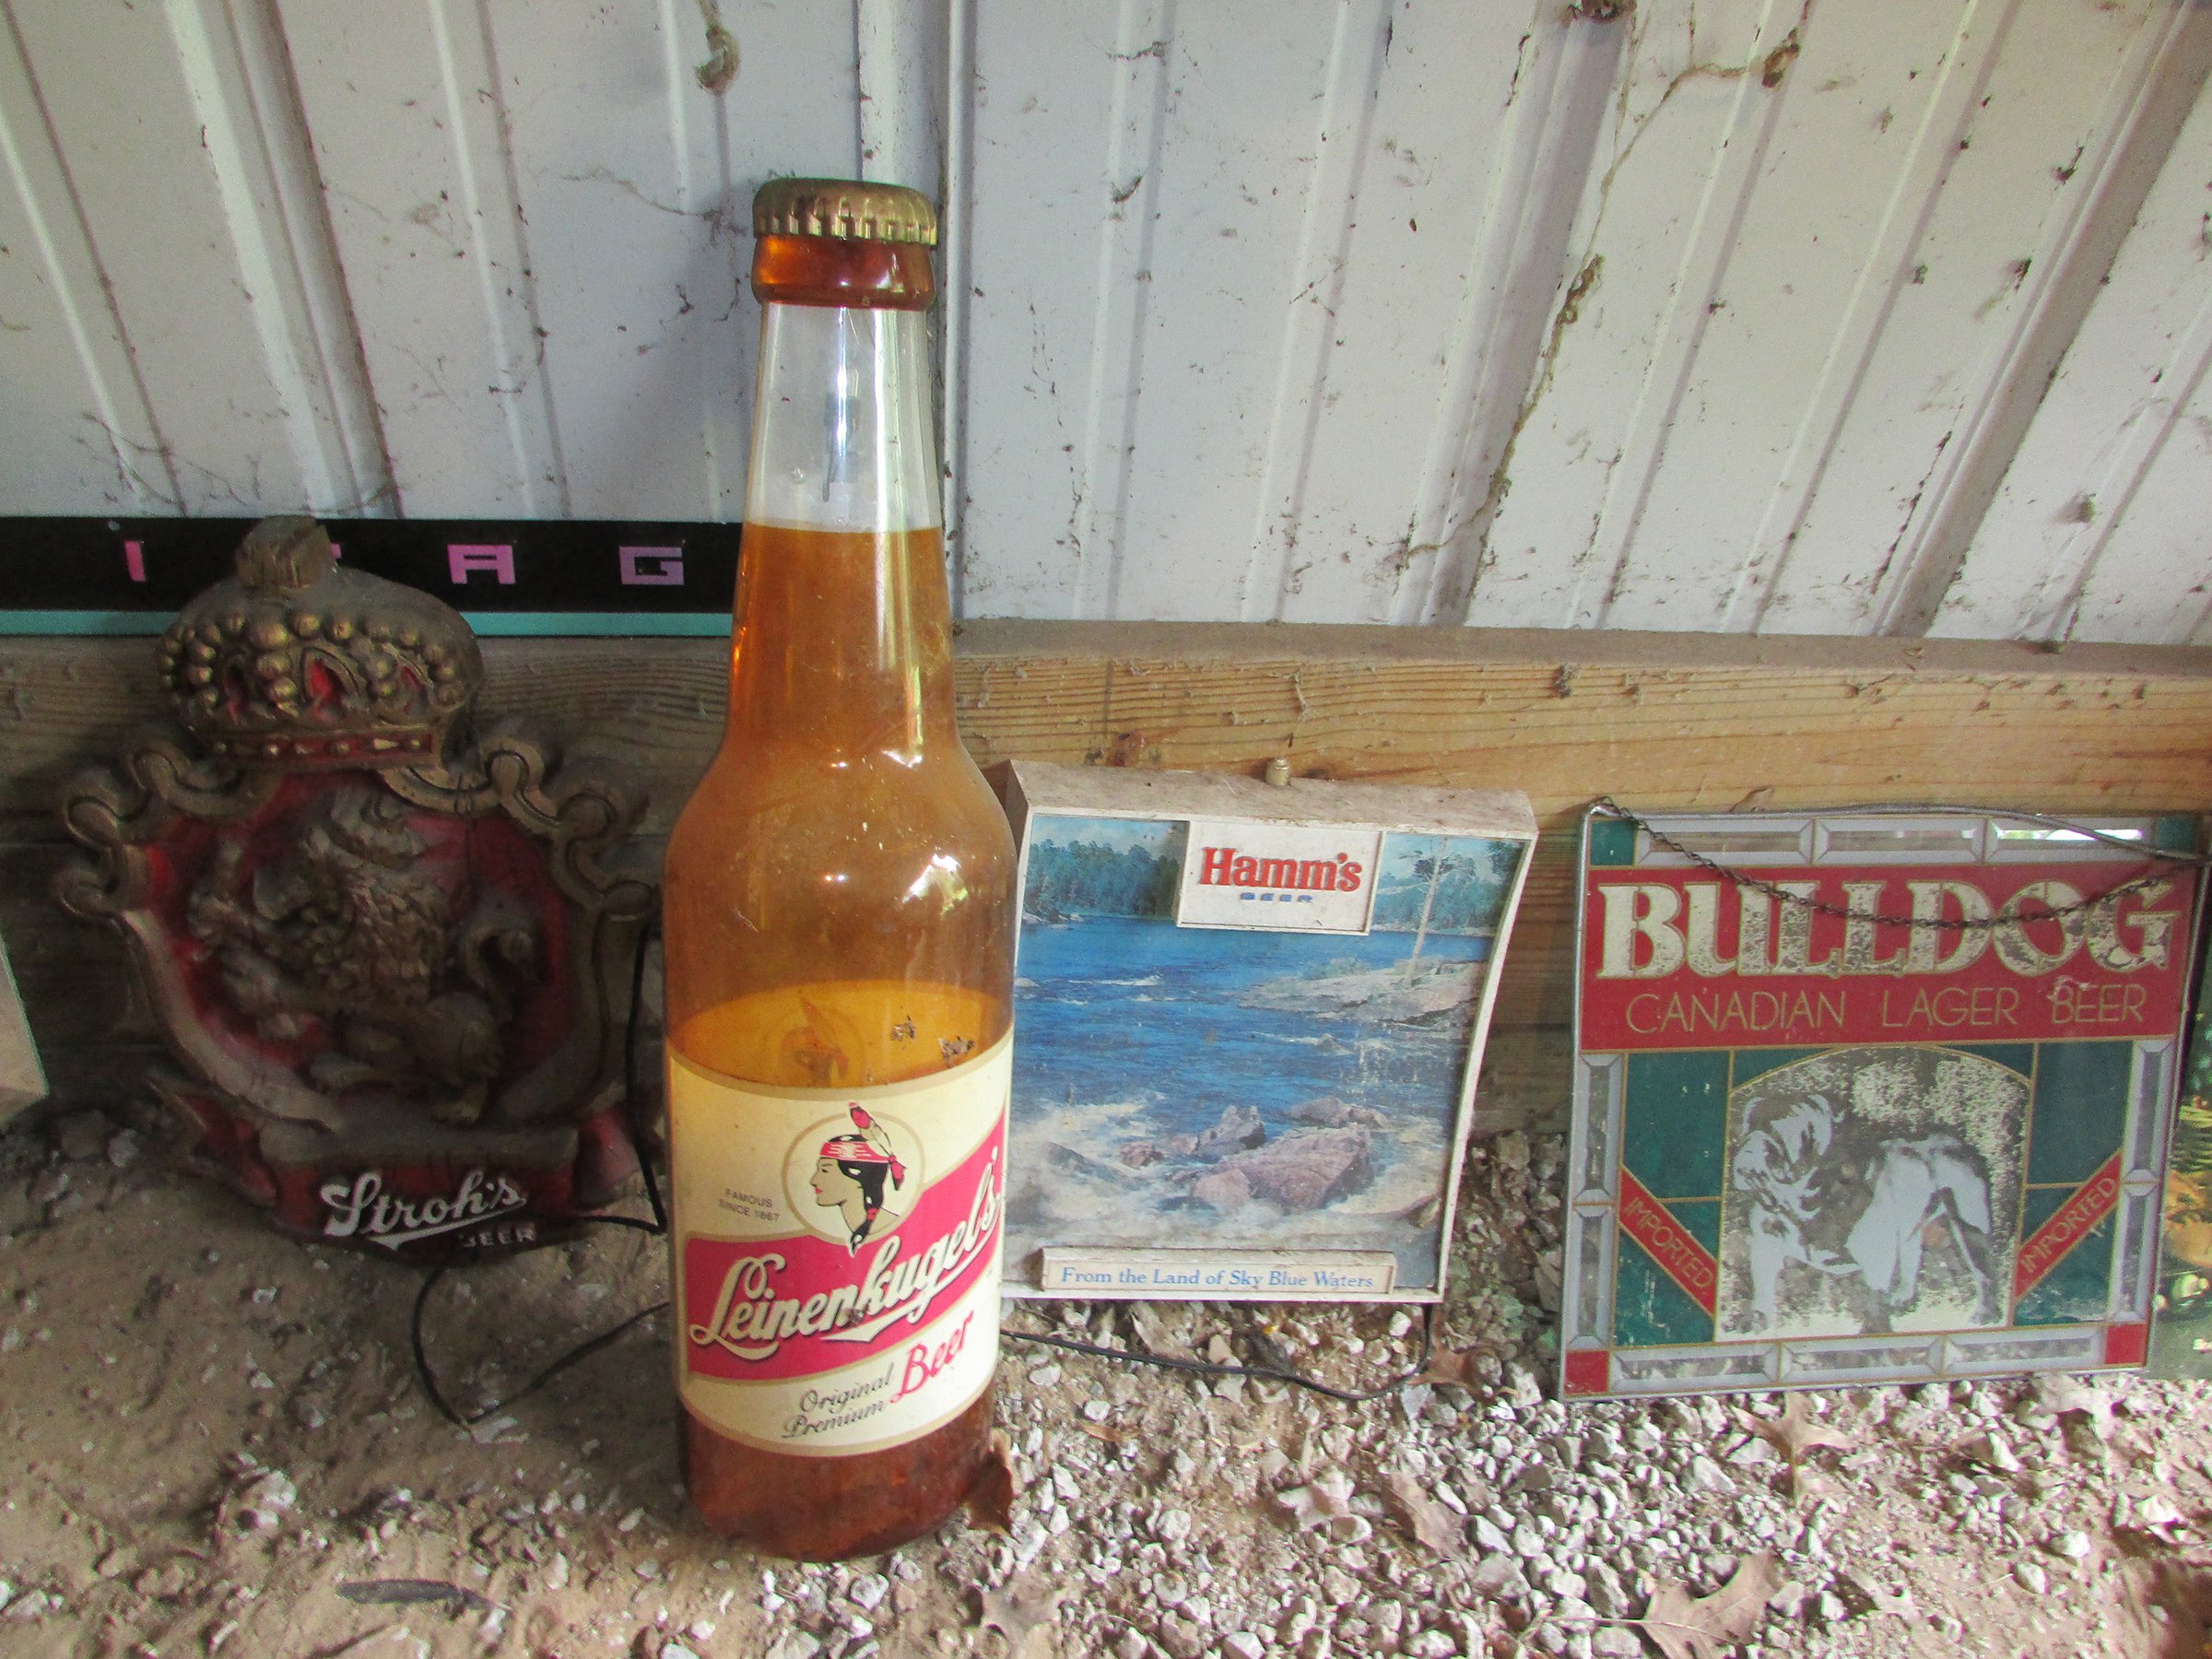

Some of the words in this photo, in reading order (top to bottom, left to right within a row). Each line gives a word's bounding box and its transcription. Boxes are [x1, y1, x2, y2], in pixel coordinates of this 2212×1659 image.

[1199, 846, 1363, 892] Hamm's
[1596, 877, 2181, 979] BULLDOG
[1626, 991, 1846, 1033] CANADIAN
[1882, 986, 2020, 1028] LAGER
[2050, 982, 2147, 1025] BEER
[320, 1171, 529, 1251] Stroh's
[718, 1198, 751, 1217] SINCE
[724, 1187, 773, 1208] FAMOUS
[2019, 1177, 2117, 1273] IMPORTED
[691, 1146, 1001, 1361] Leinenkugel's
[1622, 1196, 1714, 1288] IMPORTED
[1061, 1267, 1112, 1284] From
[1118, 1268, 1147, 1284] the
[1152, 1268, 1201, 1286] Land
[1205, 1270, 1226, 1286] of
[1229, 1270, 1264, 1289] Sky
[1267, 1270, 1309, 1287] Blue
[1312, 1271, 1373, 1288] Waters
[888, 1310, 975, 1405] Beer
[799, 1360, 895, 1415] Original
[782, 1399, 886, 1439] Premium
